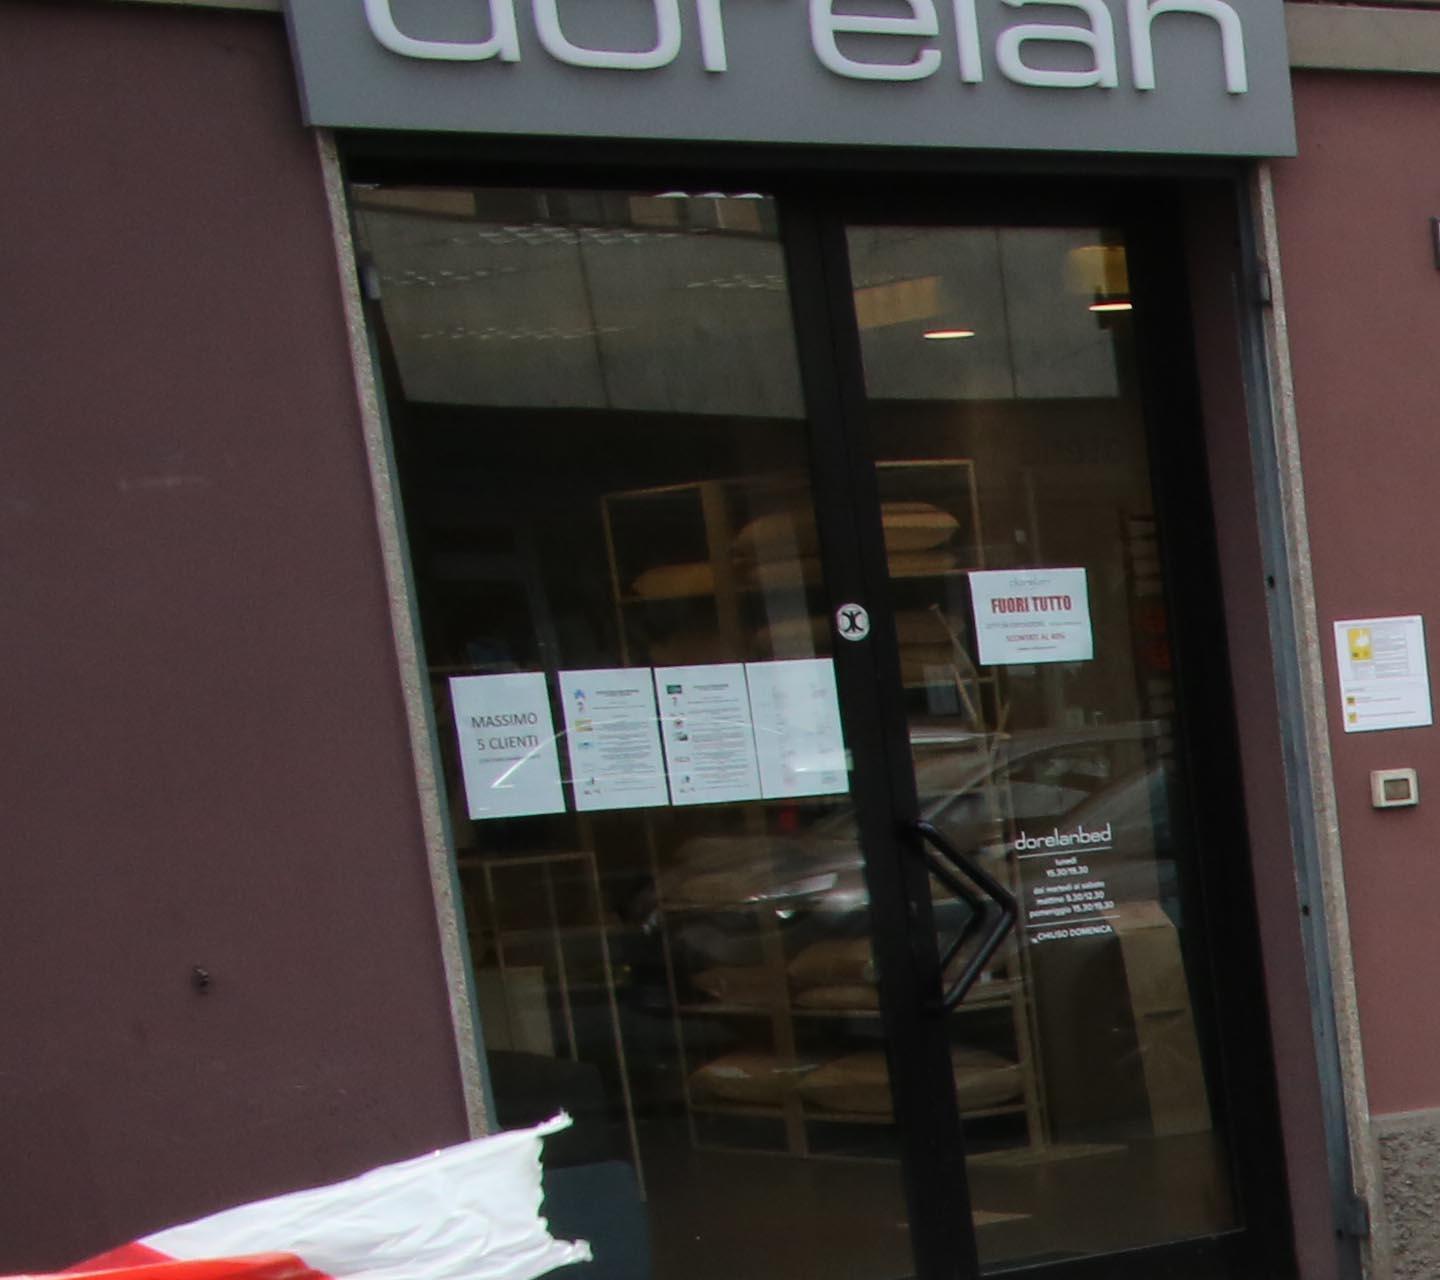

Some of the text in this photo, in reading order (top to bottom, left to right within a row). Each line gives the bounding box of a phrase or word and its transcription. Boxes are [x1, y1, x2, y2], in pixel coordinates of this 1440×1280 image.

[990, 595, 1073, 614] FUORI TUTTO
[471, 712, 538, 729] MASSIMO
[477, 735, 540, 751] 5 CLIENTI
[1015, 822, 1112, 850] dorelanbed
